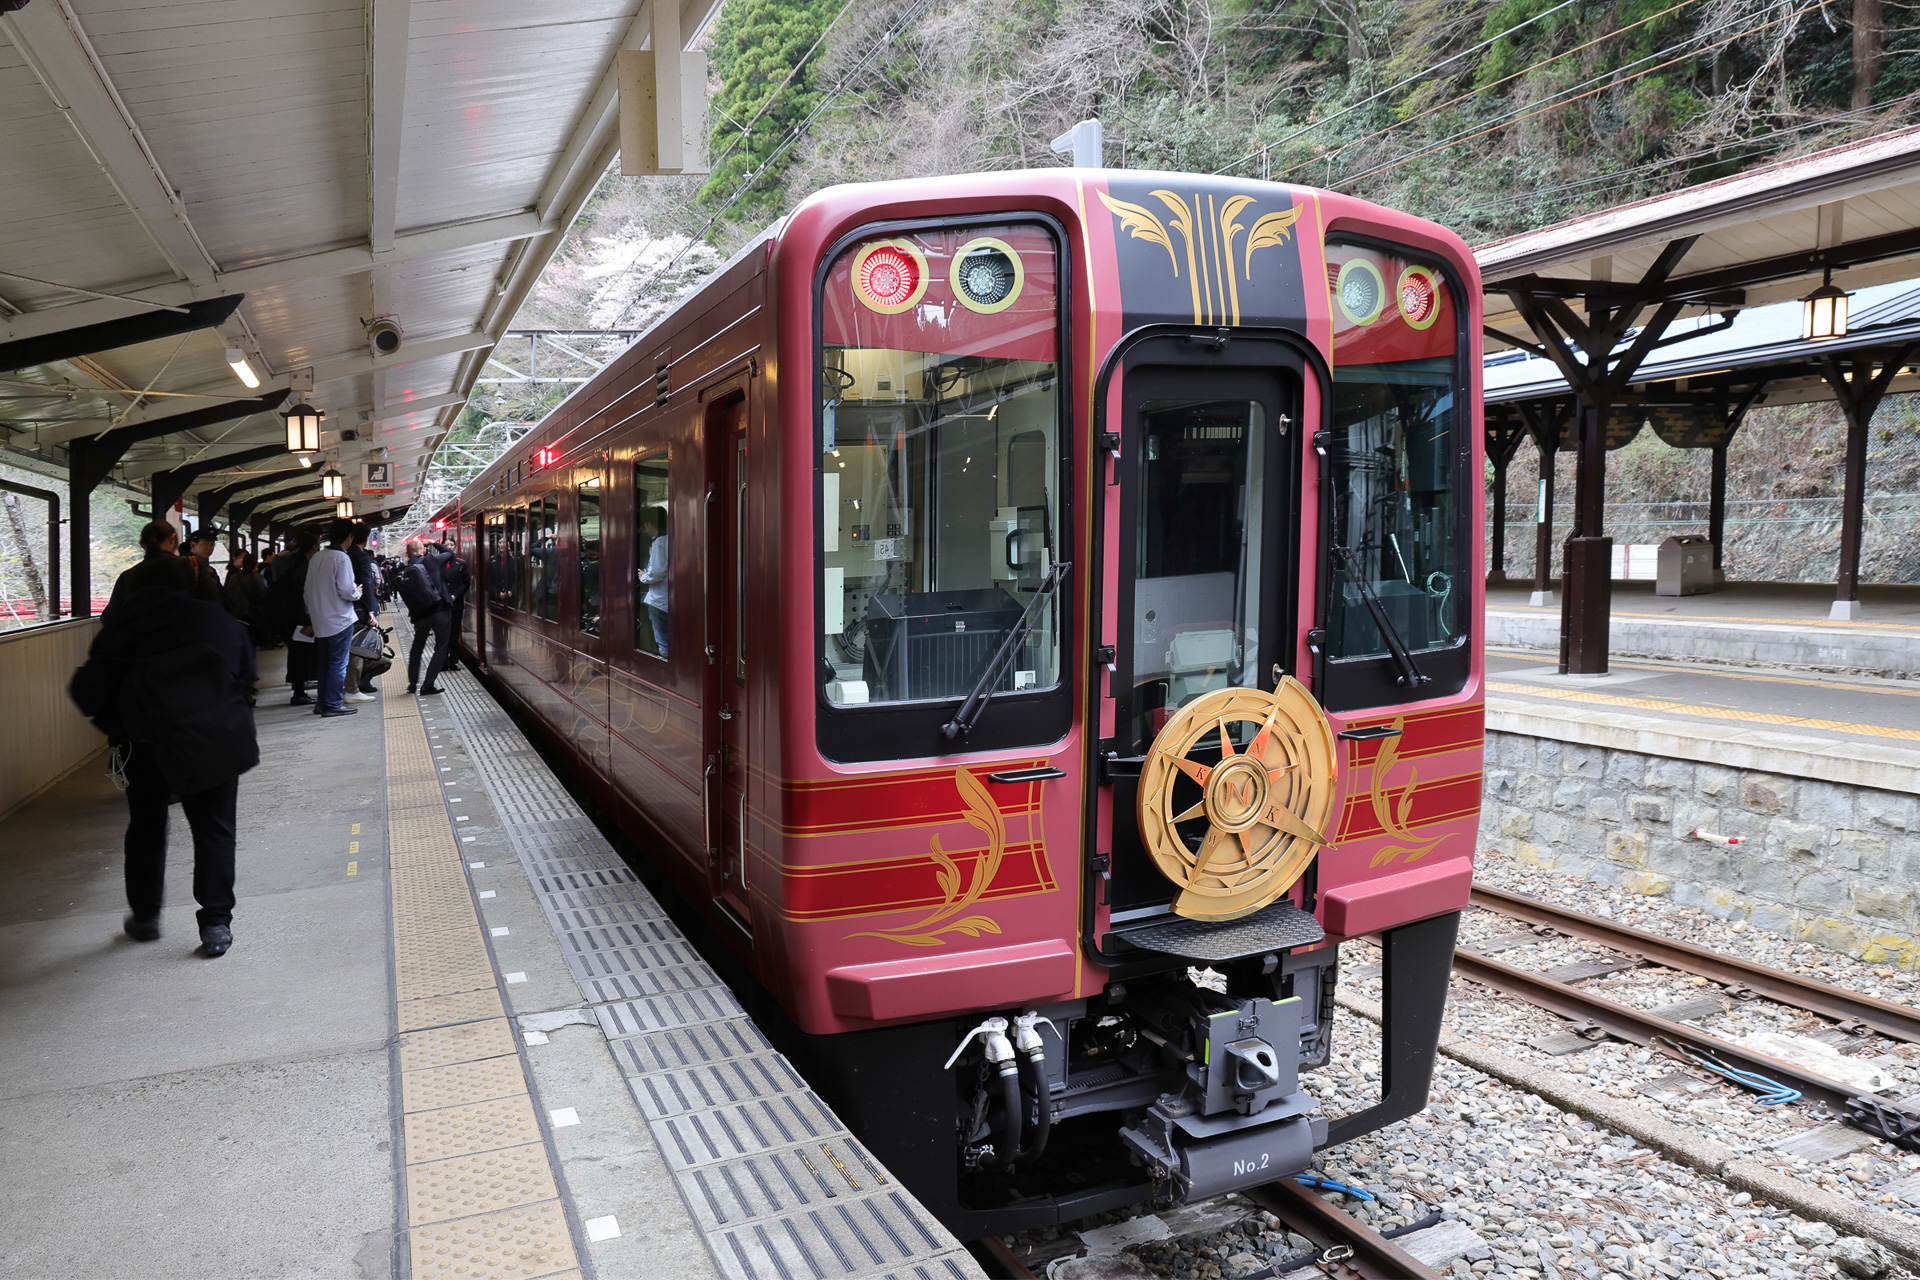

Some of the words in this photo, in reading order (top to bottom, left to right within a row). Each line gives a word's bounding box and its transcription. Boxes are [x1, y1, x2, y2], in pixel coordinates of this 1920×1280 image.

[1252, 742, 1264, 754] N
[1195, 767, 1207, 780] K
[1265, 805, 1280, 823] K
[1233, 1152, 1269, 1176] No.2
